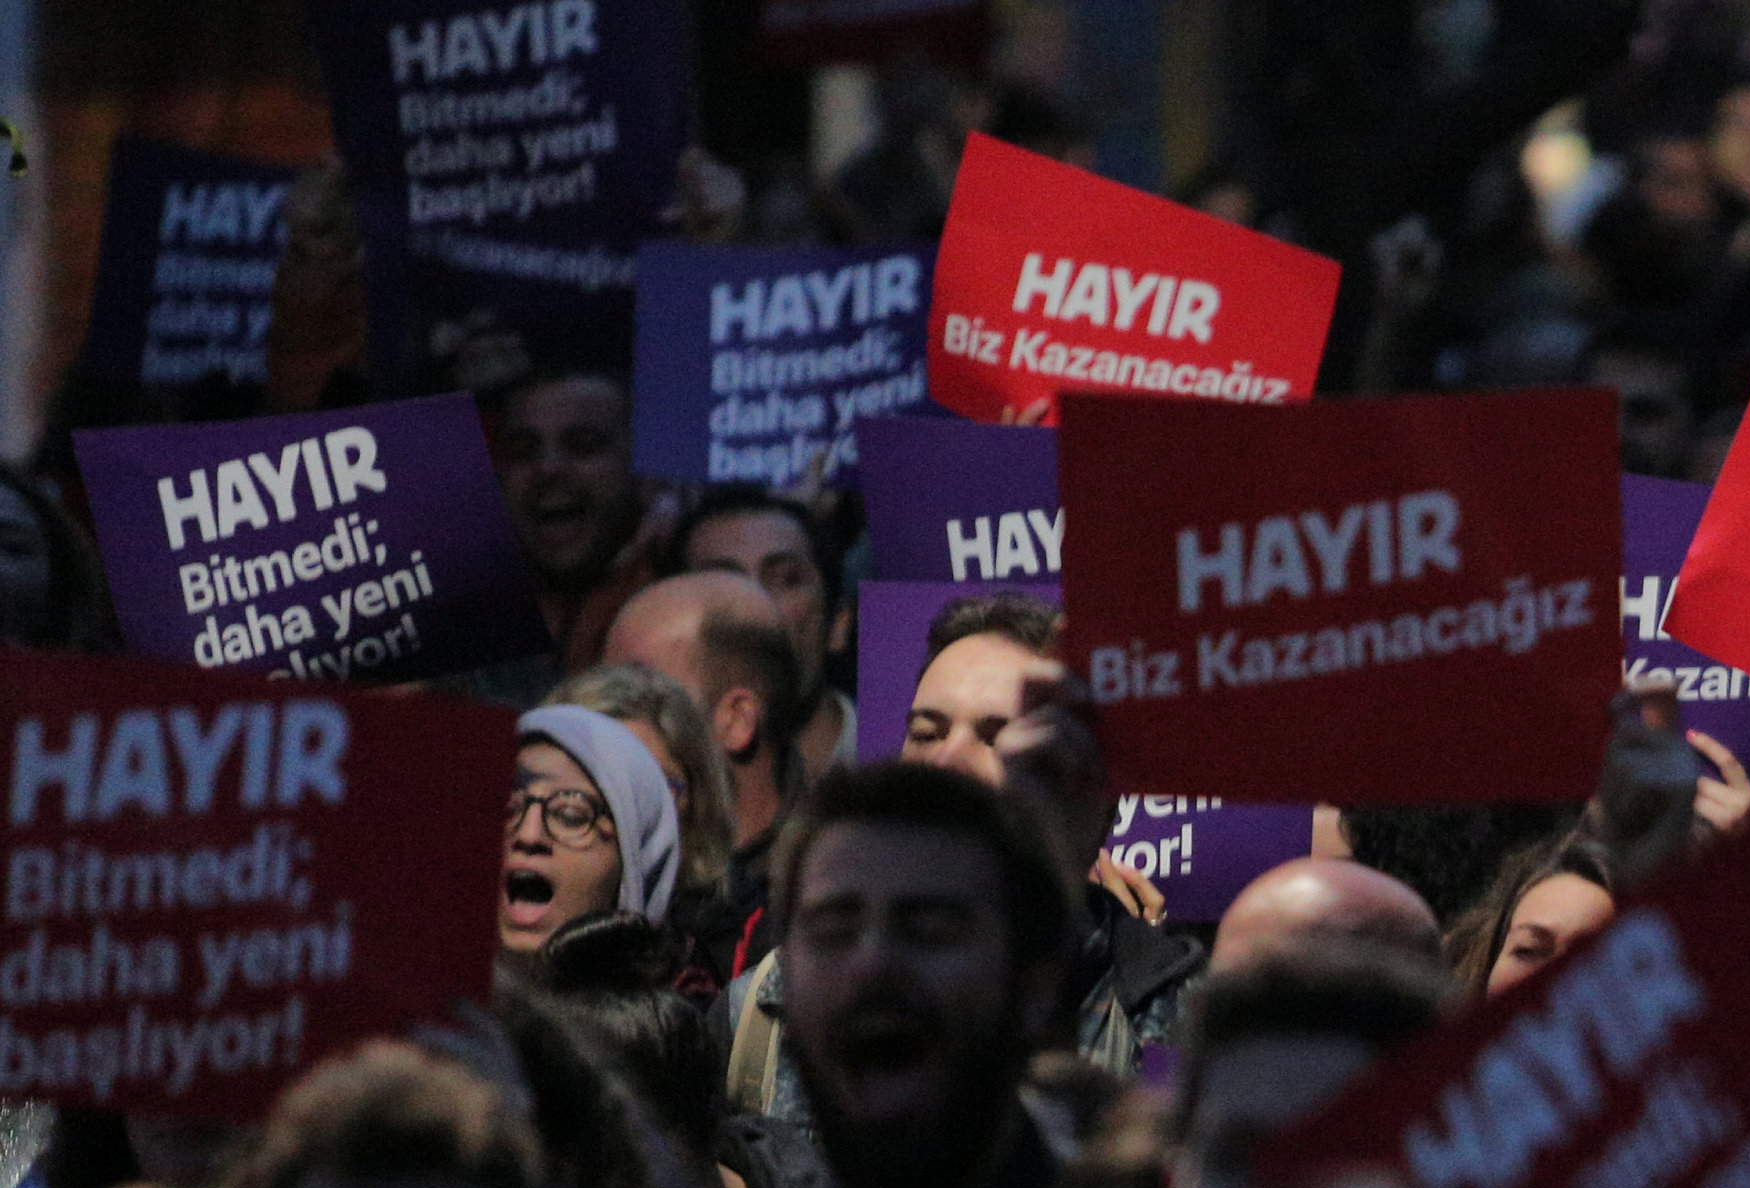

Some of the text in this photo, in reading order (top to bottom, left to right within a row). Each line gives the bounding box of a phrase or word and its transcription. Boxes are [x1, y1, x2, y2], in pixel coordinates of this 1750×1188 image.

[388, 0, 599, 83] HAYIR
[711, 255, 921, 344] HAYIR
[943, 313, 1005, 366] Biz
[1012, 252, 1222, 345] HAYIR
[711, 325, 901, 394] Bitmedi;
[708, 392, 828, 437] daha
[157, 425, 388, 552] HAYIR
[179, 512, 388, 614] Bitmedi;
[1176, 489, 1462, 617] HAYIR
[194, 551, 434, 669] daha yeni
[1090, 573, 1593, 705] Biz Kazanacağız
[8, 698, 351, 826] HAYIR
[7, 820, 314, 920] Bitmedi;
[0, 898, 355, 1008] daha yeni
